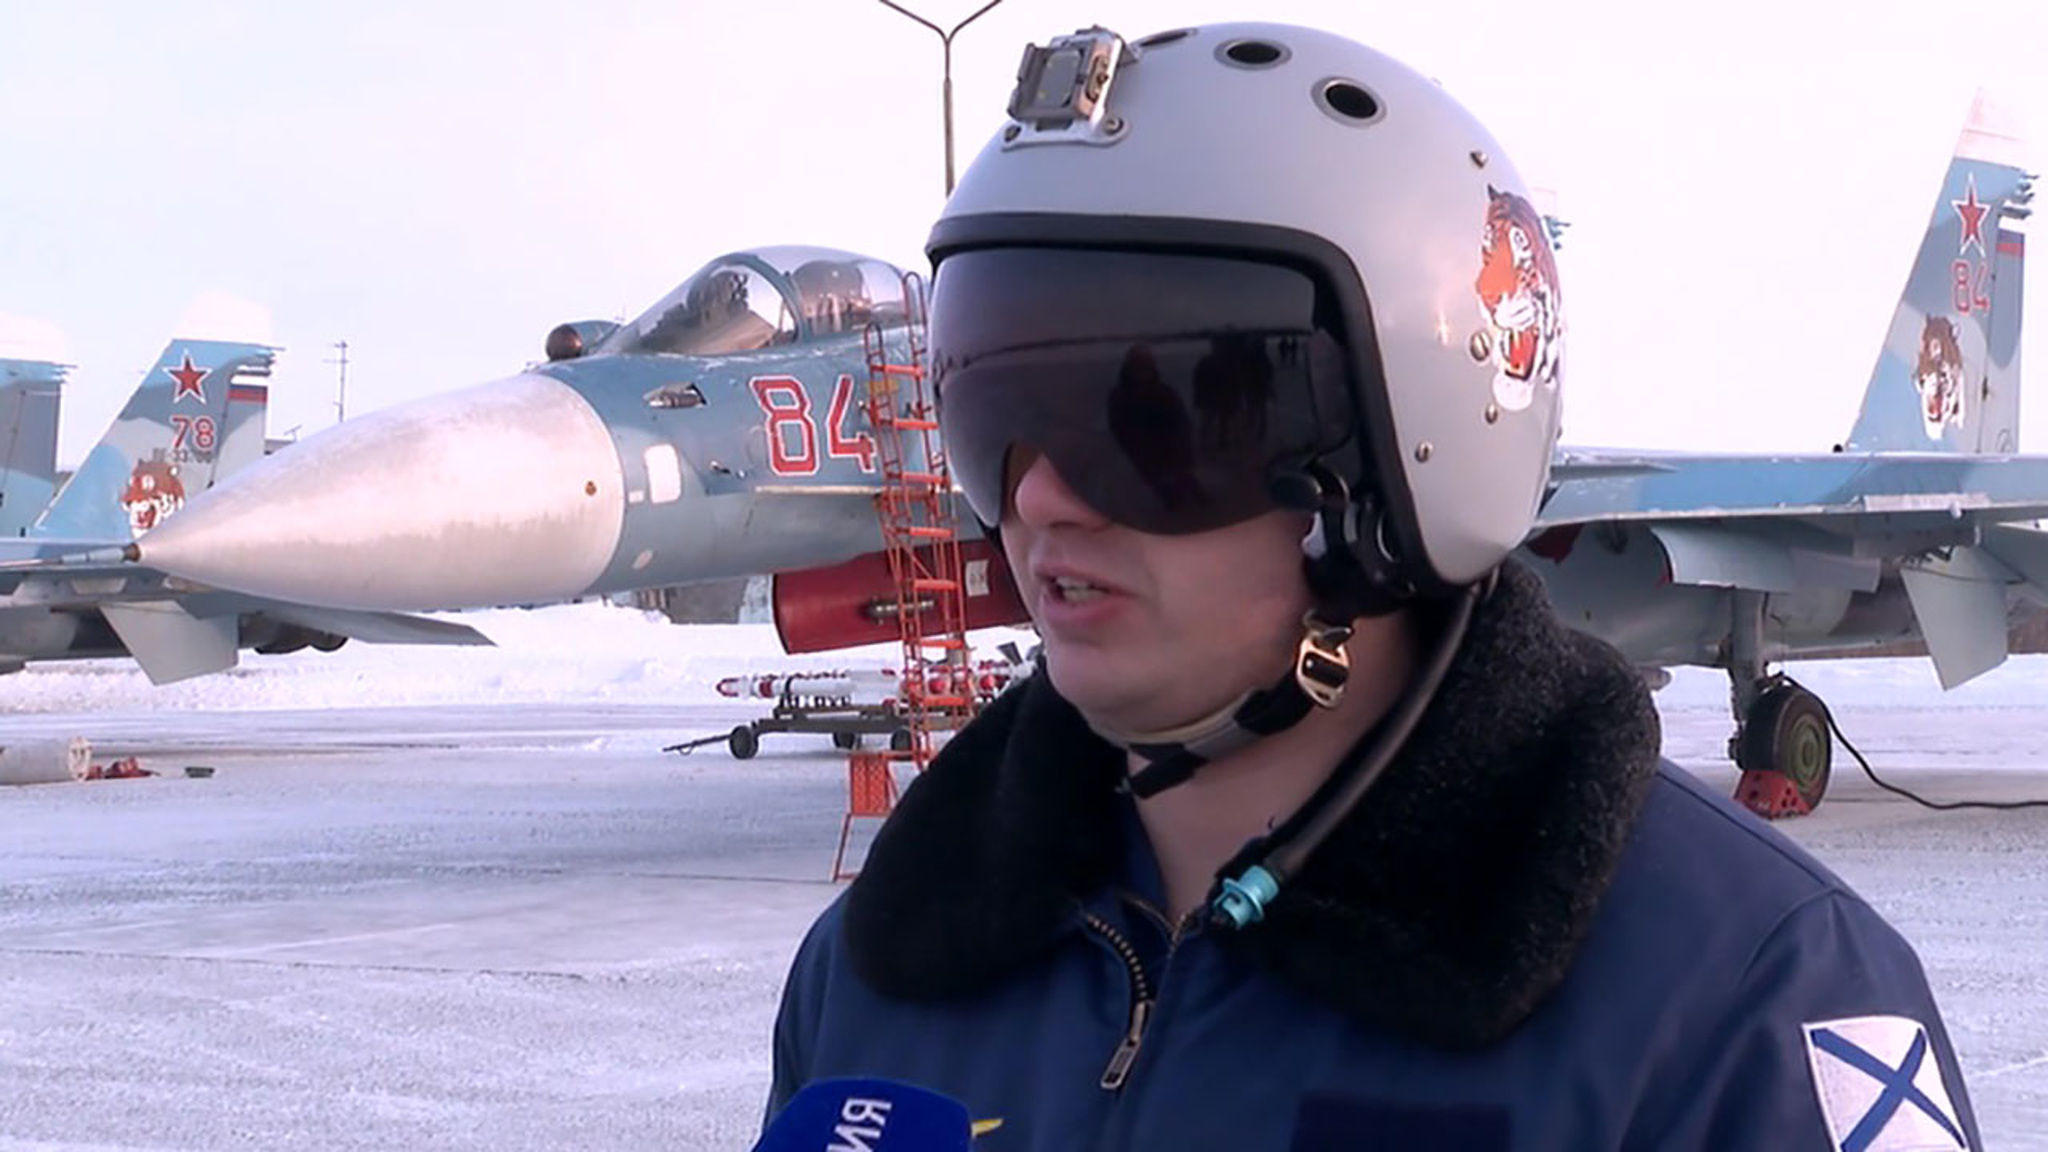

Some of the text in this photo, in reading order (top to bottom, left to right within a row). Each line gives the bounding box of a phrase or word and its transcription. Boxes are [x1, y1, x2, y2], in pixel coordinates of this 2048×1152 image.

[1953, 260, 1990, 314] 84
[171, 414, 215, 450] 78
[750, 373, 877, 476] 84
